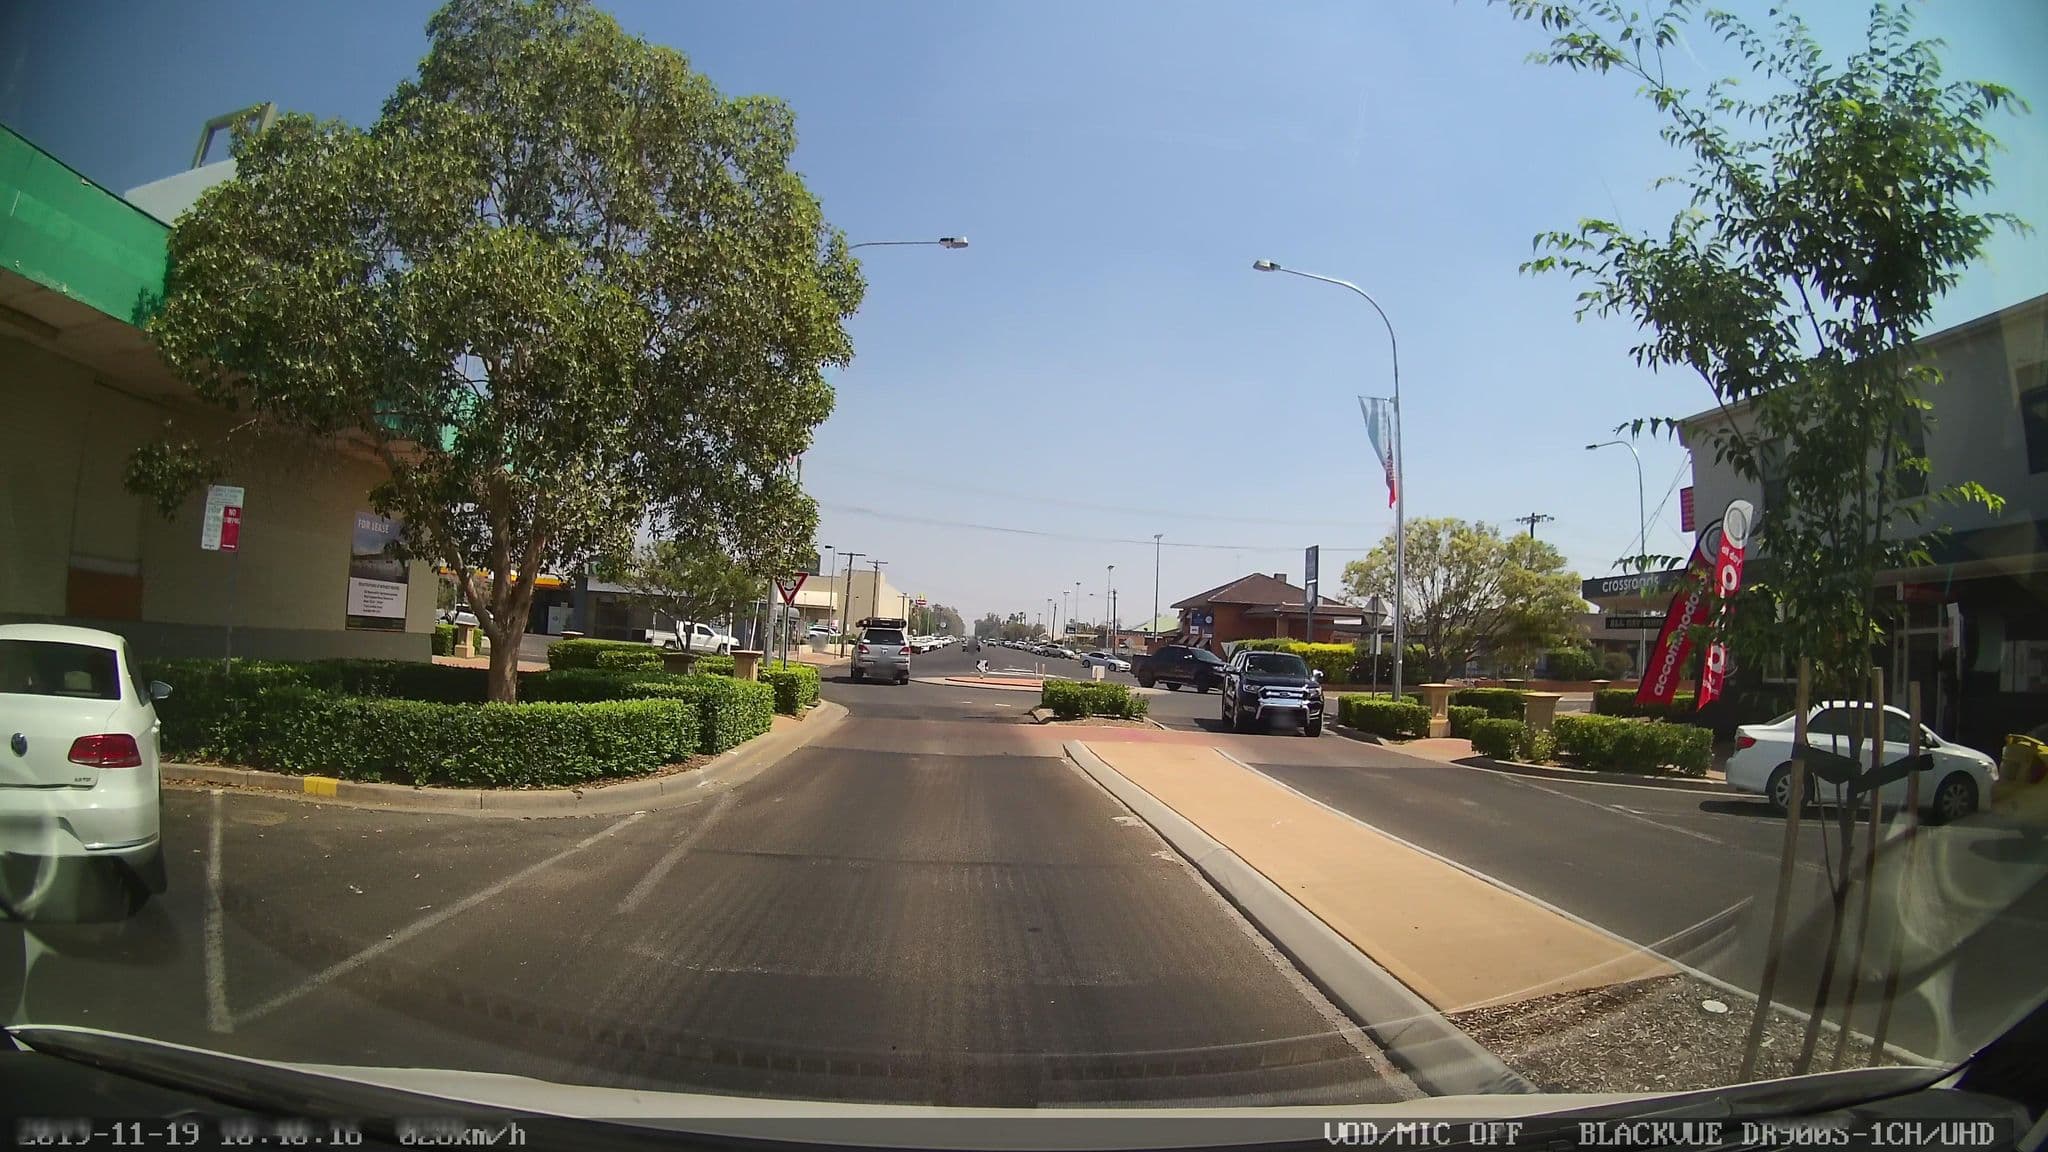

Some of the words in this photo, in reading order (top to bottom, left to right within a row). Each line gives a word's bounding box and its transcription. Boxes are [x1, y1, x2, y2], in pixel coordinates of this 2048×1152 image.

[358, 519, 371, 530] FOR
[371, 521, 389, 534] LEASE
[1602, 574, 1659, 593] crossroads
